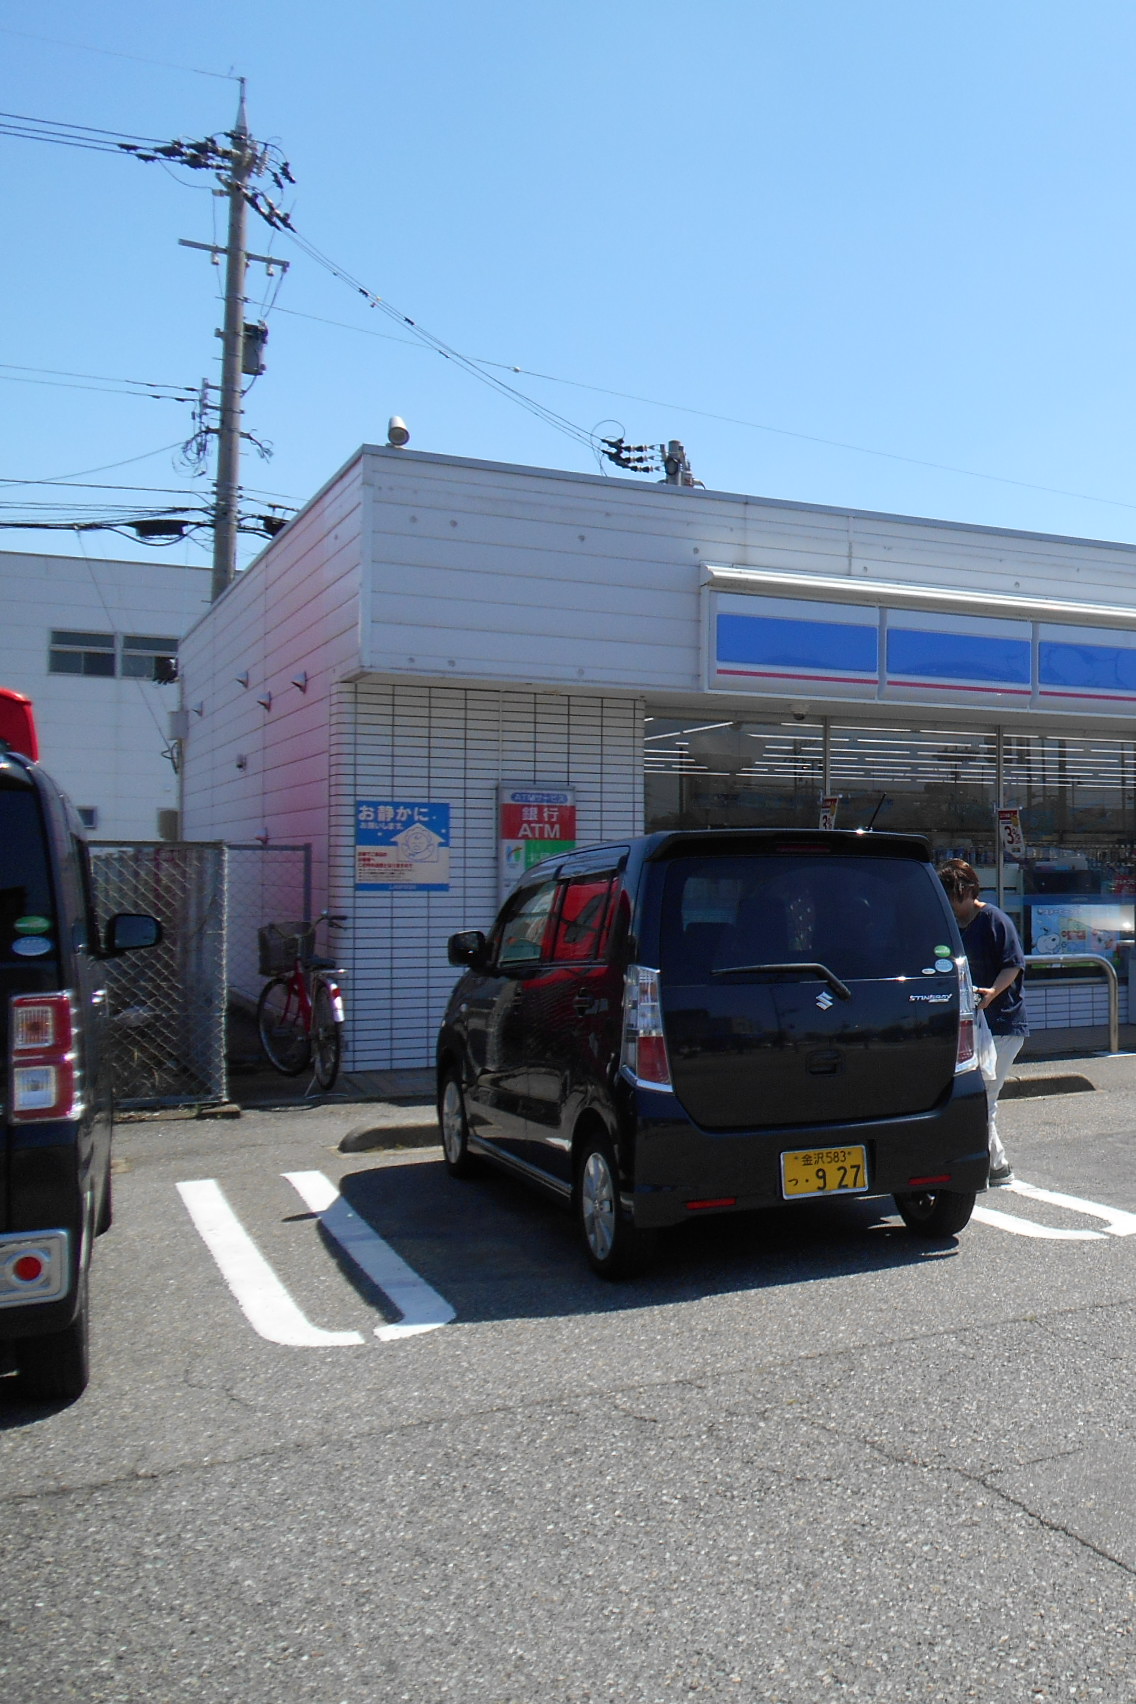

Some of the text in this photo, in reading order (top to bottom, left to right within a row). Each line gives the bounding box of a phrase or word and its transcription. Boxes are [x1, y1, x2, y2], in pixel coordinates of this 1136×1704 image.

[358, 804, 430, 822] お静かに
[521, 807, 560, 822] 銀行
[517, 823, 561, 838] ATM
